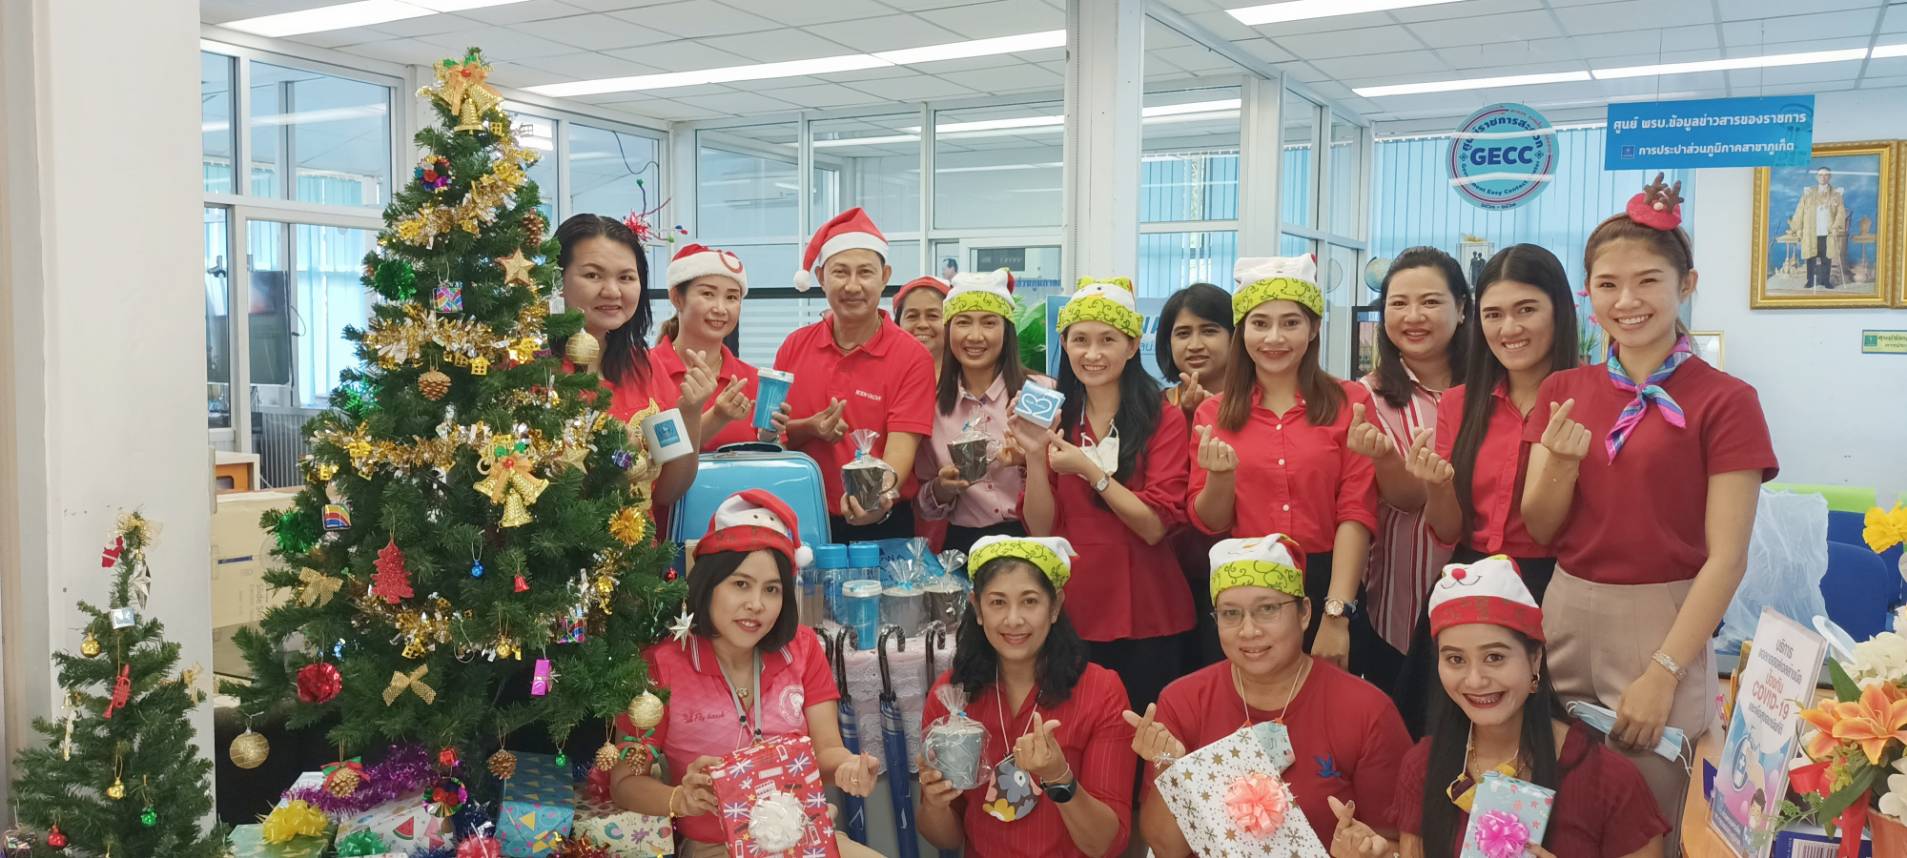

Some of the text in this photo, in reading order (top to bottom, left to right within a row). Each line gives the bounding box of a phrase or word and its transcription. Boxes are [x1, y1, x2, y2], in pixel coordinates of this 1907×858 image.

[1613, 116, 1639, 134] ศูนย์
[1470, 146, 1534, 166] GECC
[1639, 138, 1795, 157] การประปาส่วนภูมิภาคสาขาภูเก็ต
[1752, 680, 1790, 720] COVID-19
